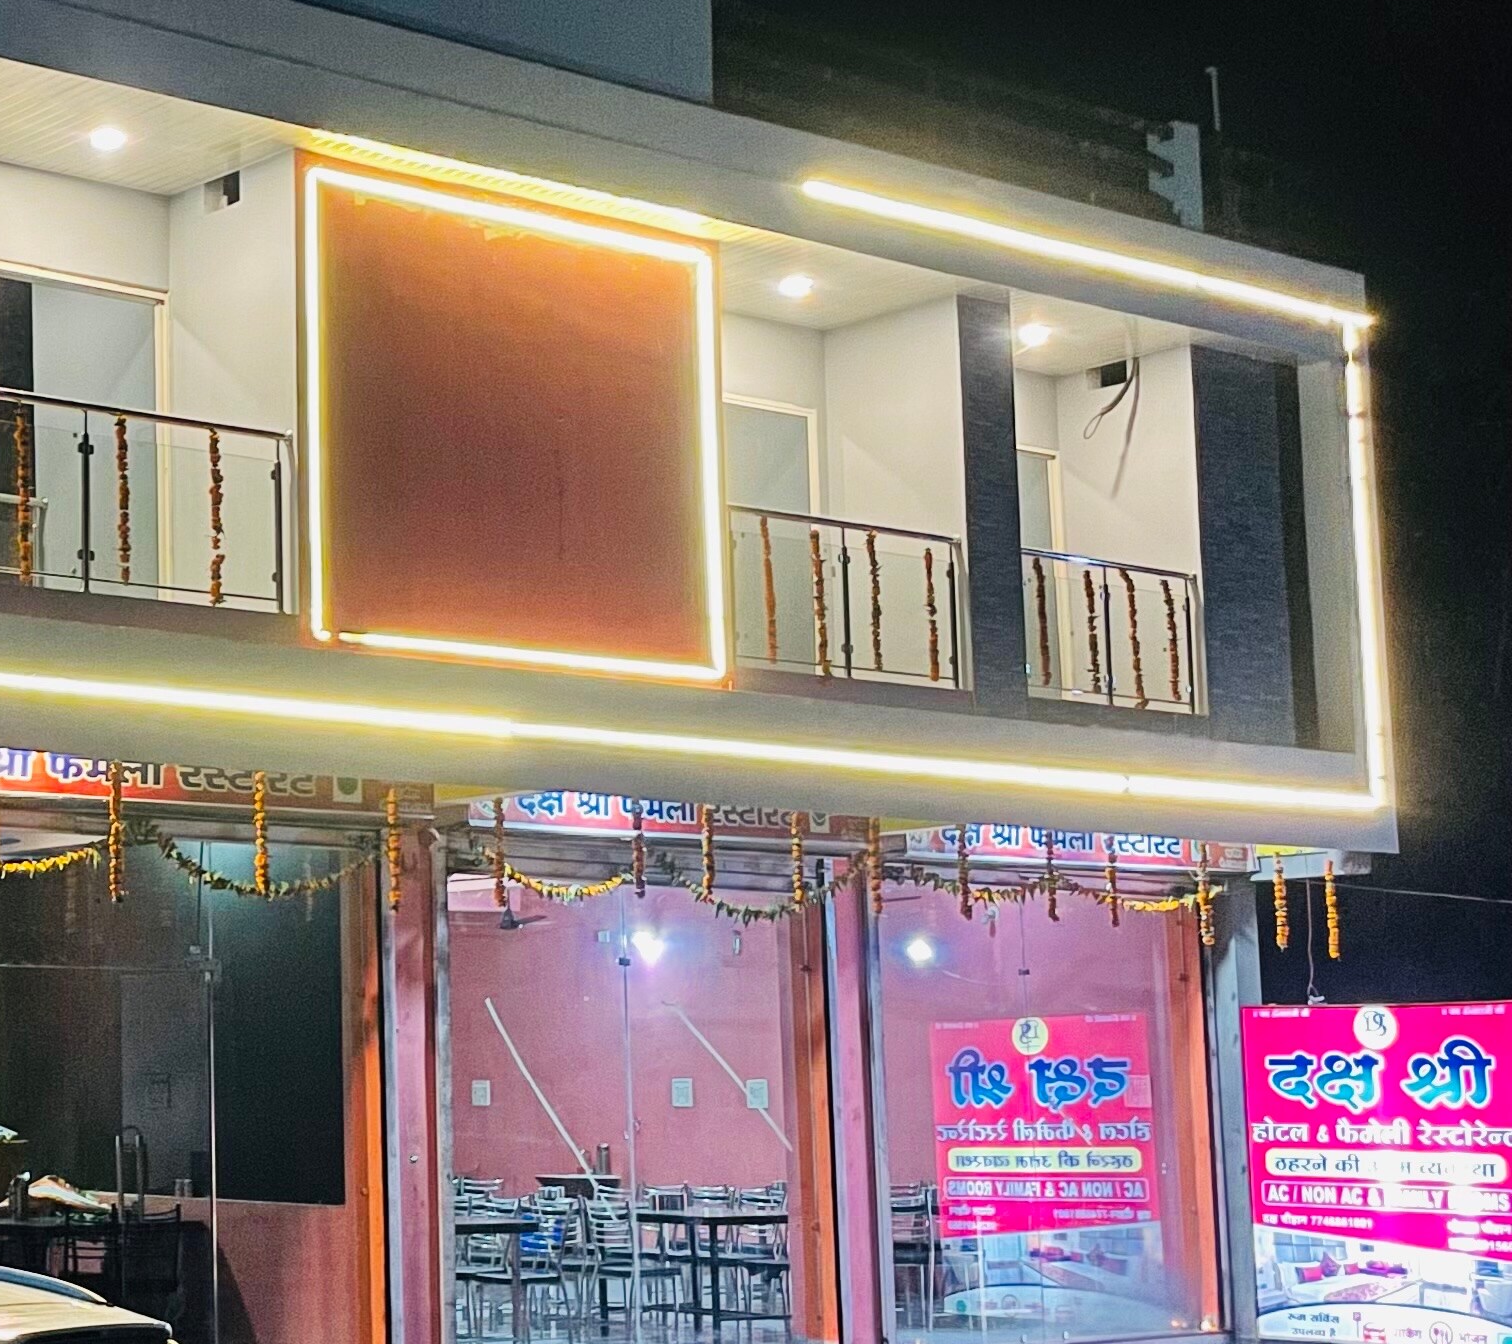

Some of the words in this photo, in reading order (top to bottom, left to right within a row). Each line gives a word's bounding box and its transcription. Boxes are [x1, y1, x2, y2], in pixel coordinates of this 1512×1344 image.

[1267, 1052, 1381, 1112] दक्ष
[1401, 1036, 1495, 1107] श्री
[1251, 1117, 1309, 1143] होटल
[1316, 1124, 1330, 1143] &
[1274, 1152, 1327, 1172] ठहरने
[1335, 1153, 1360, 1173] की
[1268, 1184, 1289, 1203] AC
[1302, 1185, 1337, 1204] NON
[1341, 1186, 1363, 1205] AC
